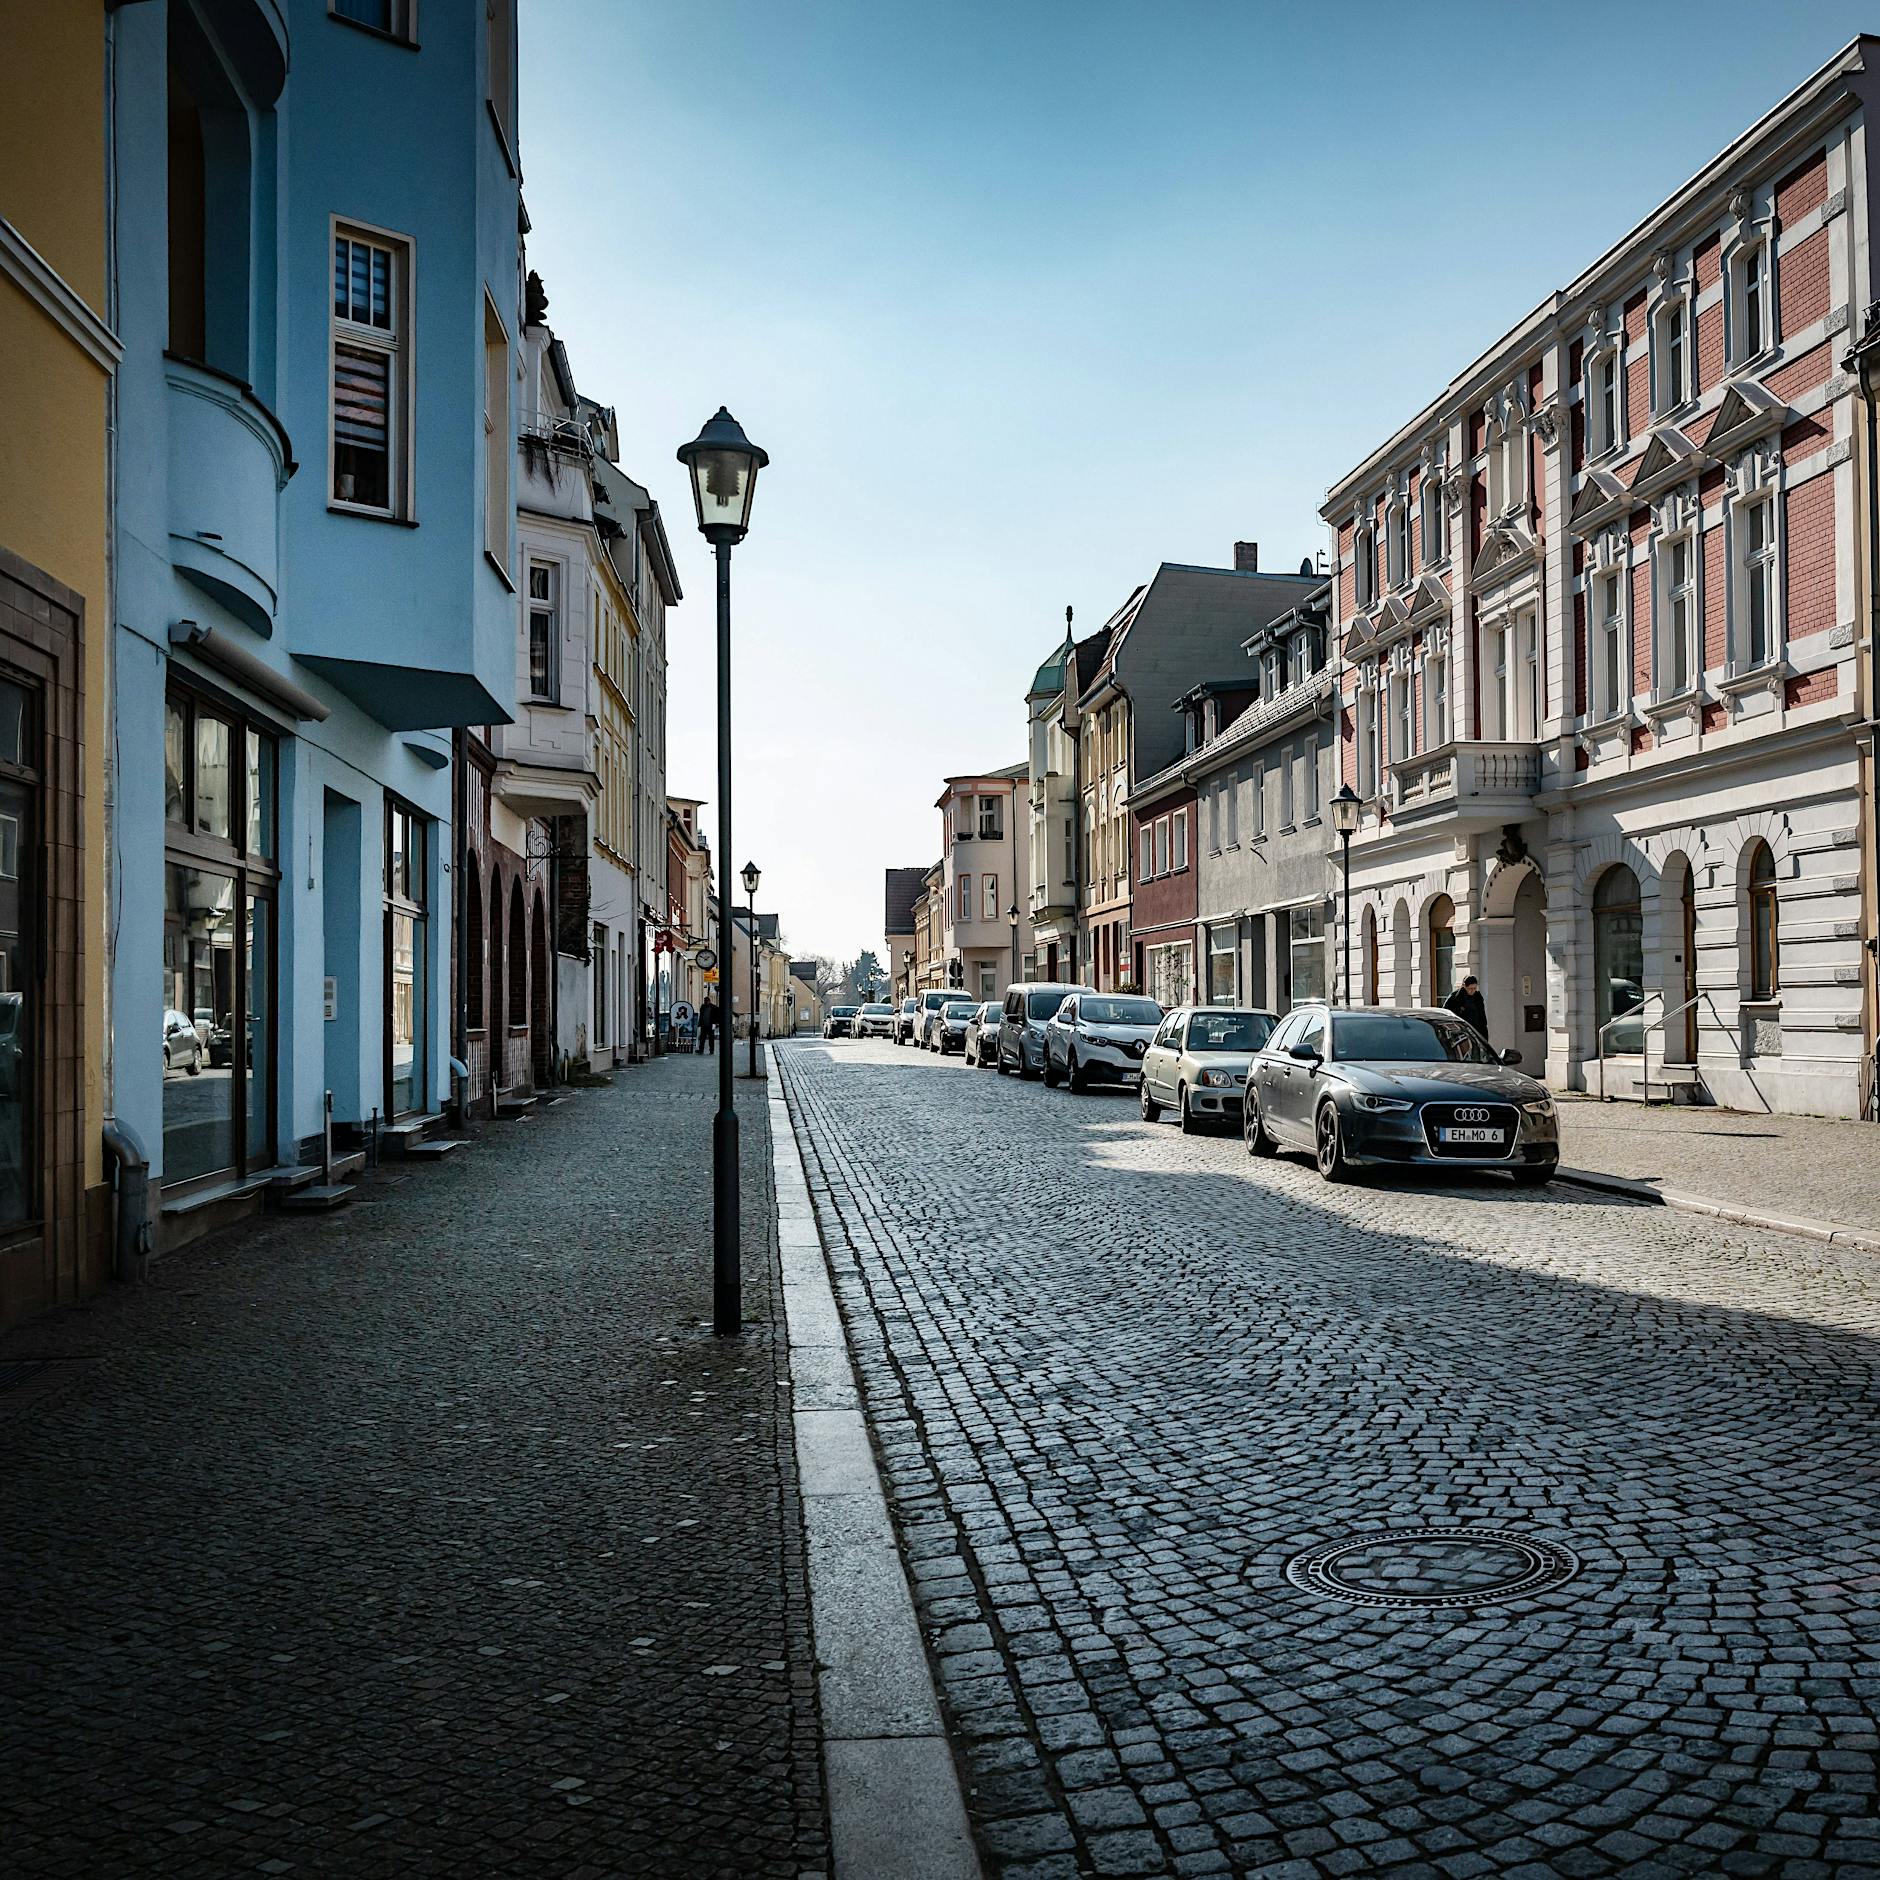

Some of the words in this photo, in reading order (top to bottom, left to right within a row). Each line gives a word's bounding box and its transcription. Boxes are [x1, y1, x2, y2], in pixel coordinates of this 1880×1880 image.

[1451, 1130, 1466, 1140] EH
[1472, 1130, 1486, 1141] MO
[1491, 1131, 1498, 1141] 6
